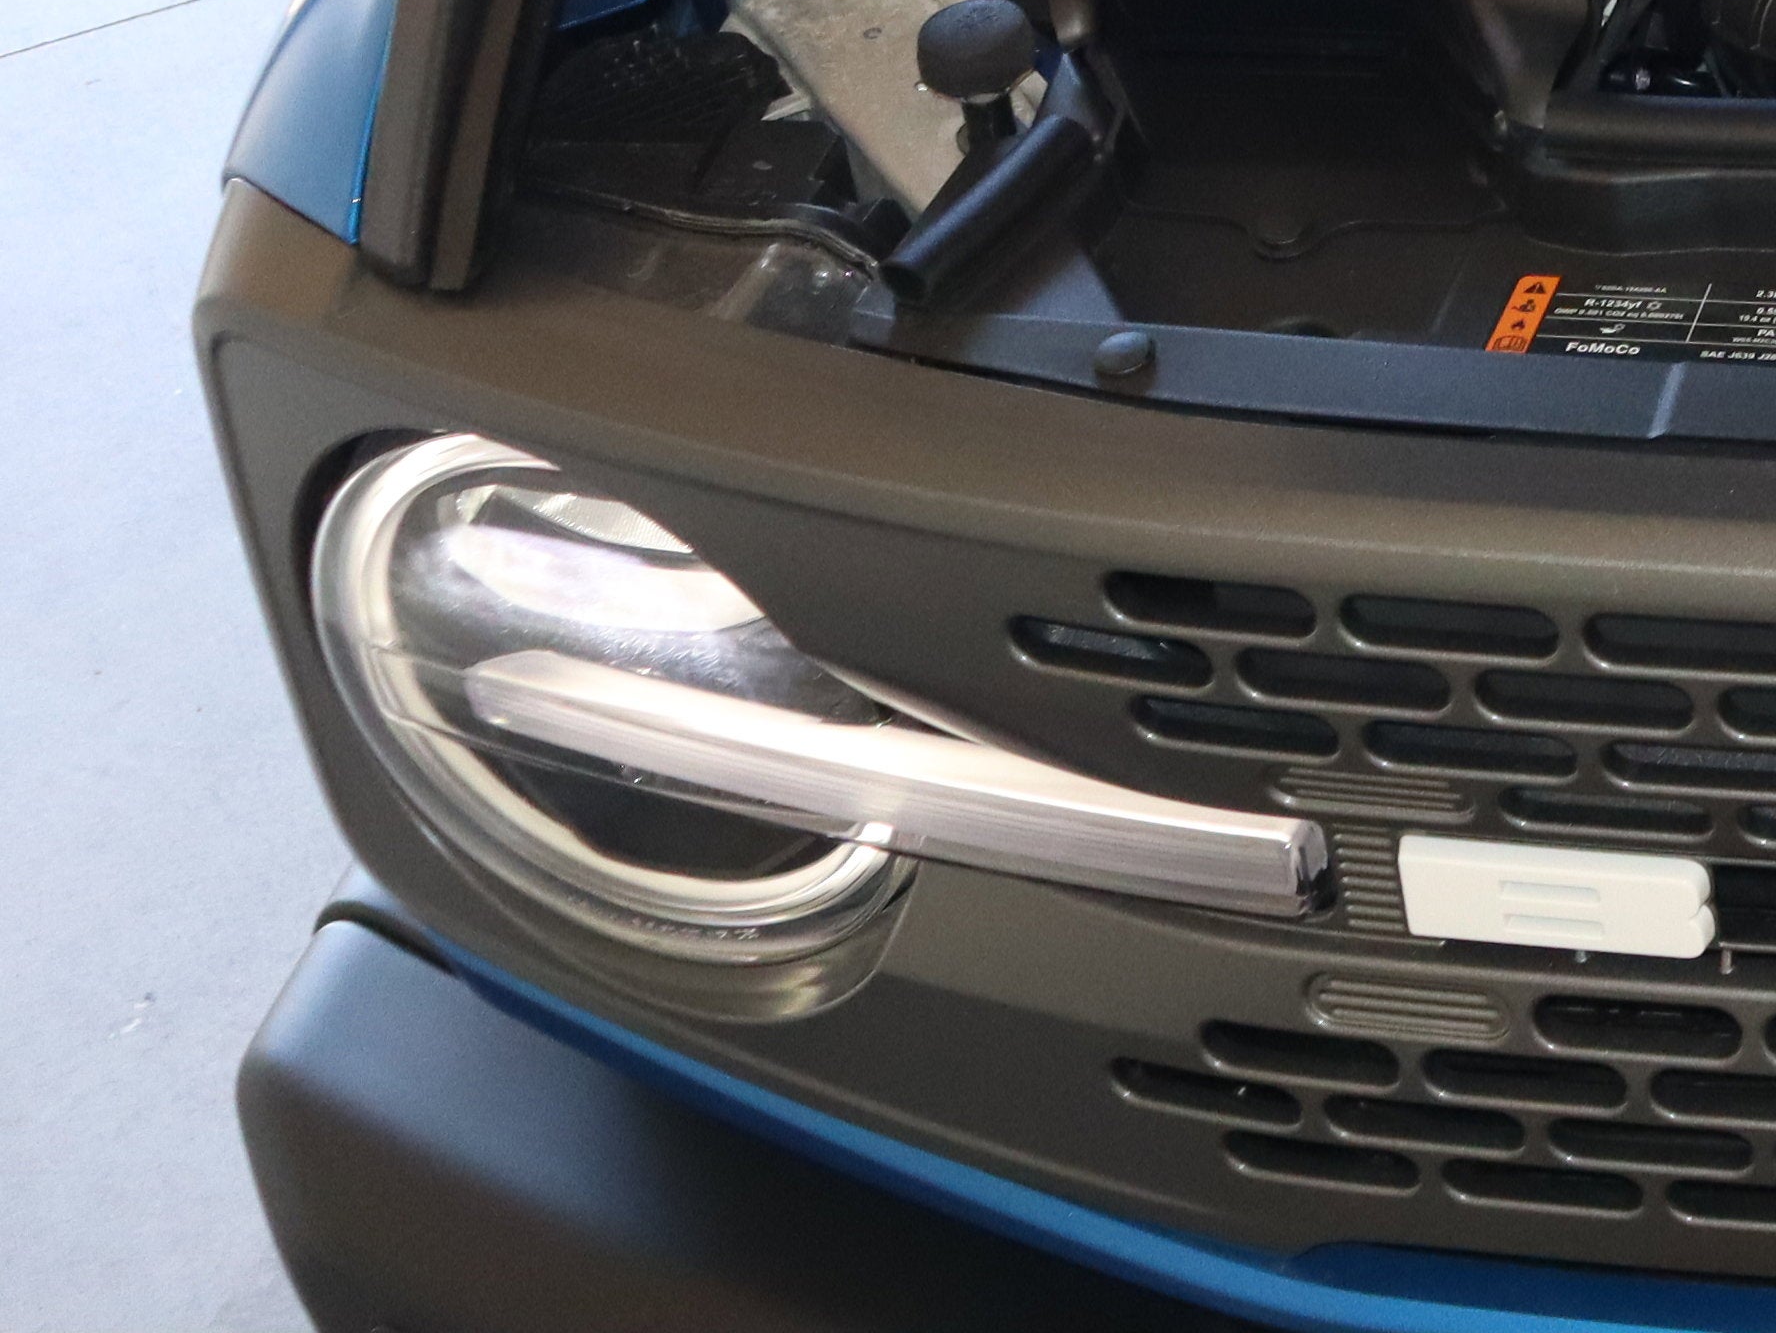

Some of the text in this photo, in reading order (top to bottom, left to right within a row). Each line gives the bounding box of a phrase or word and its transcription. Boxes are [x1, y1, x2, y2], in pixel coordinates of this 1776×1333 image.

[1584, 297, 1642, 310] R-1234yf
[1565, 341, 1641, 356] FoMoCo
[1699, 350, 1726, 359] SAE
